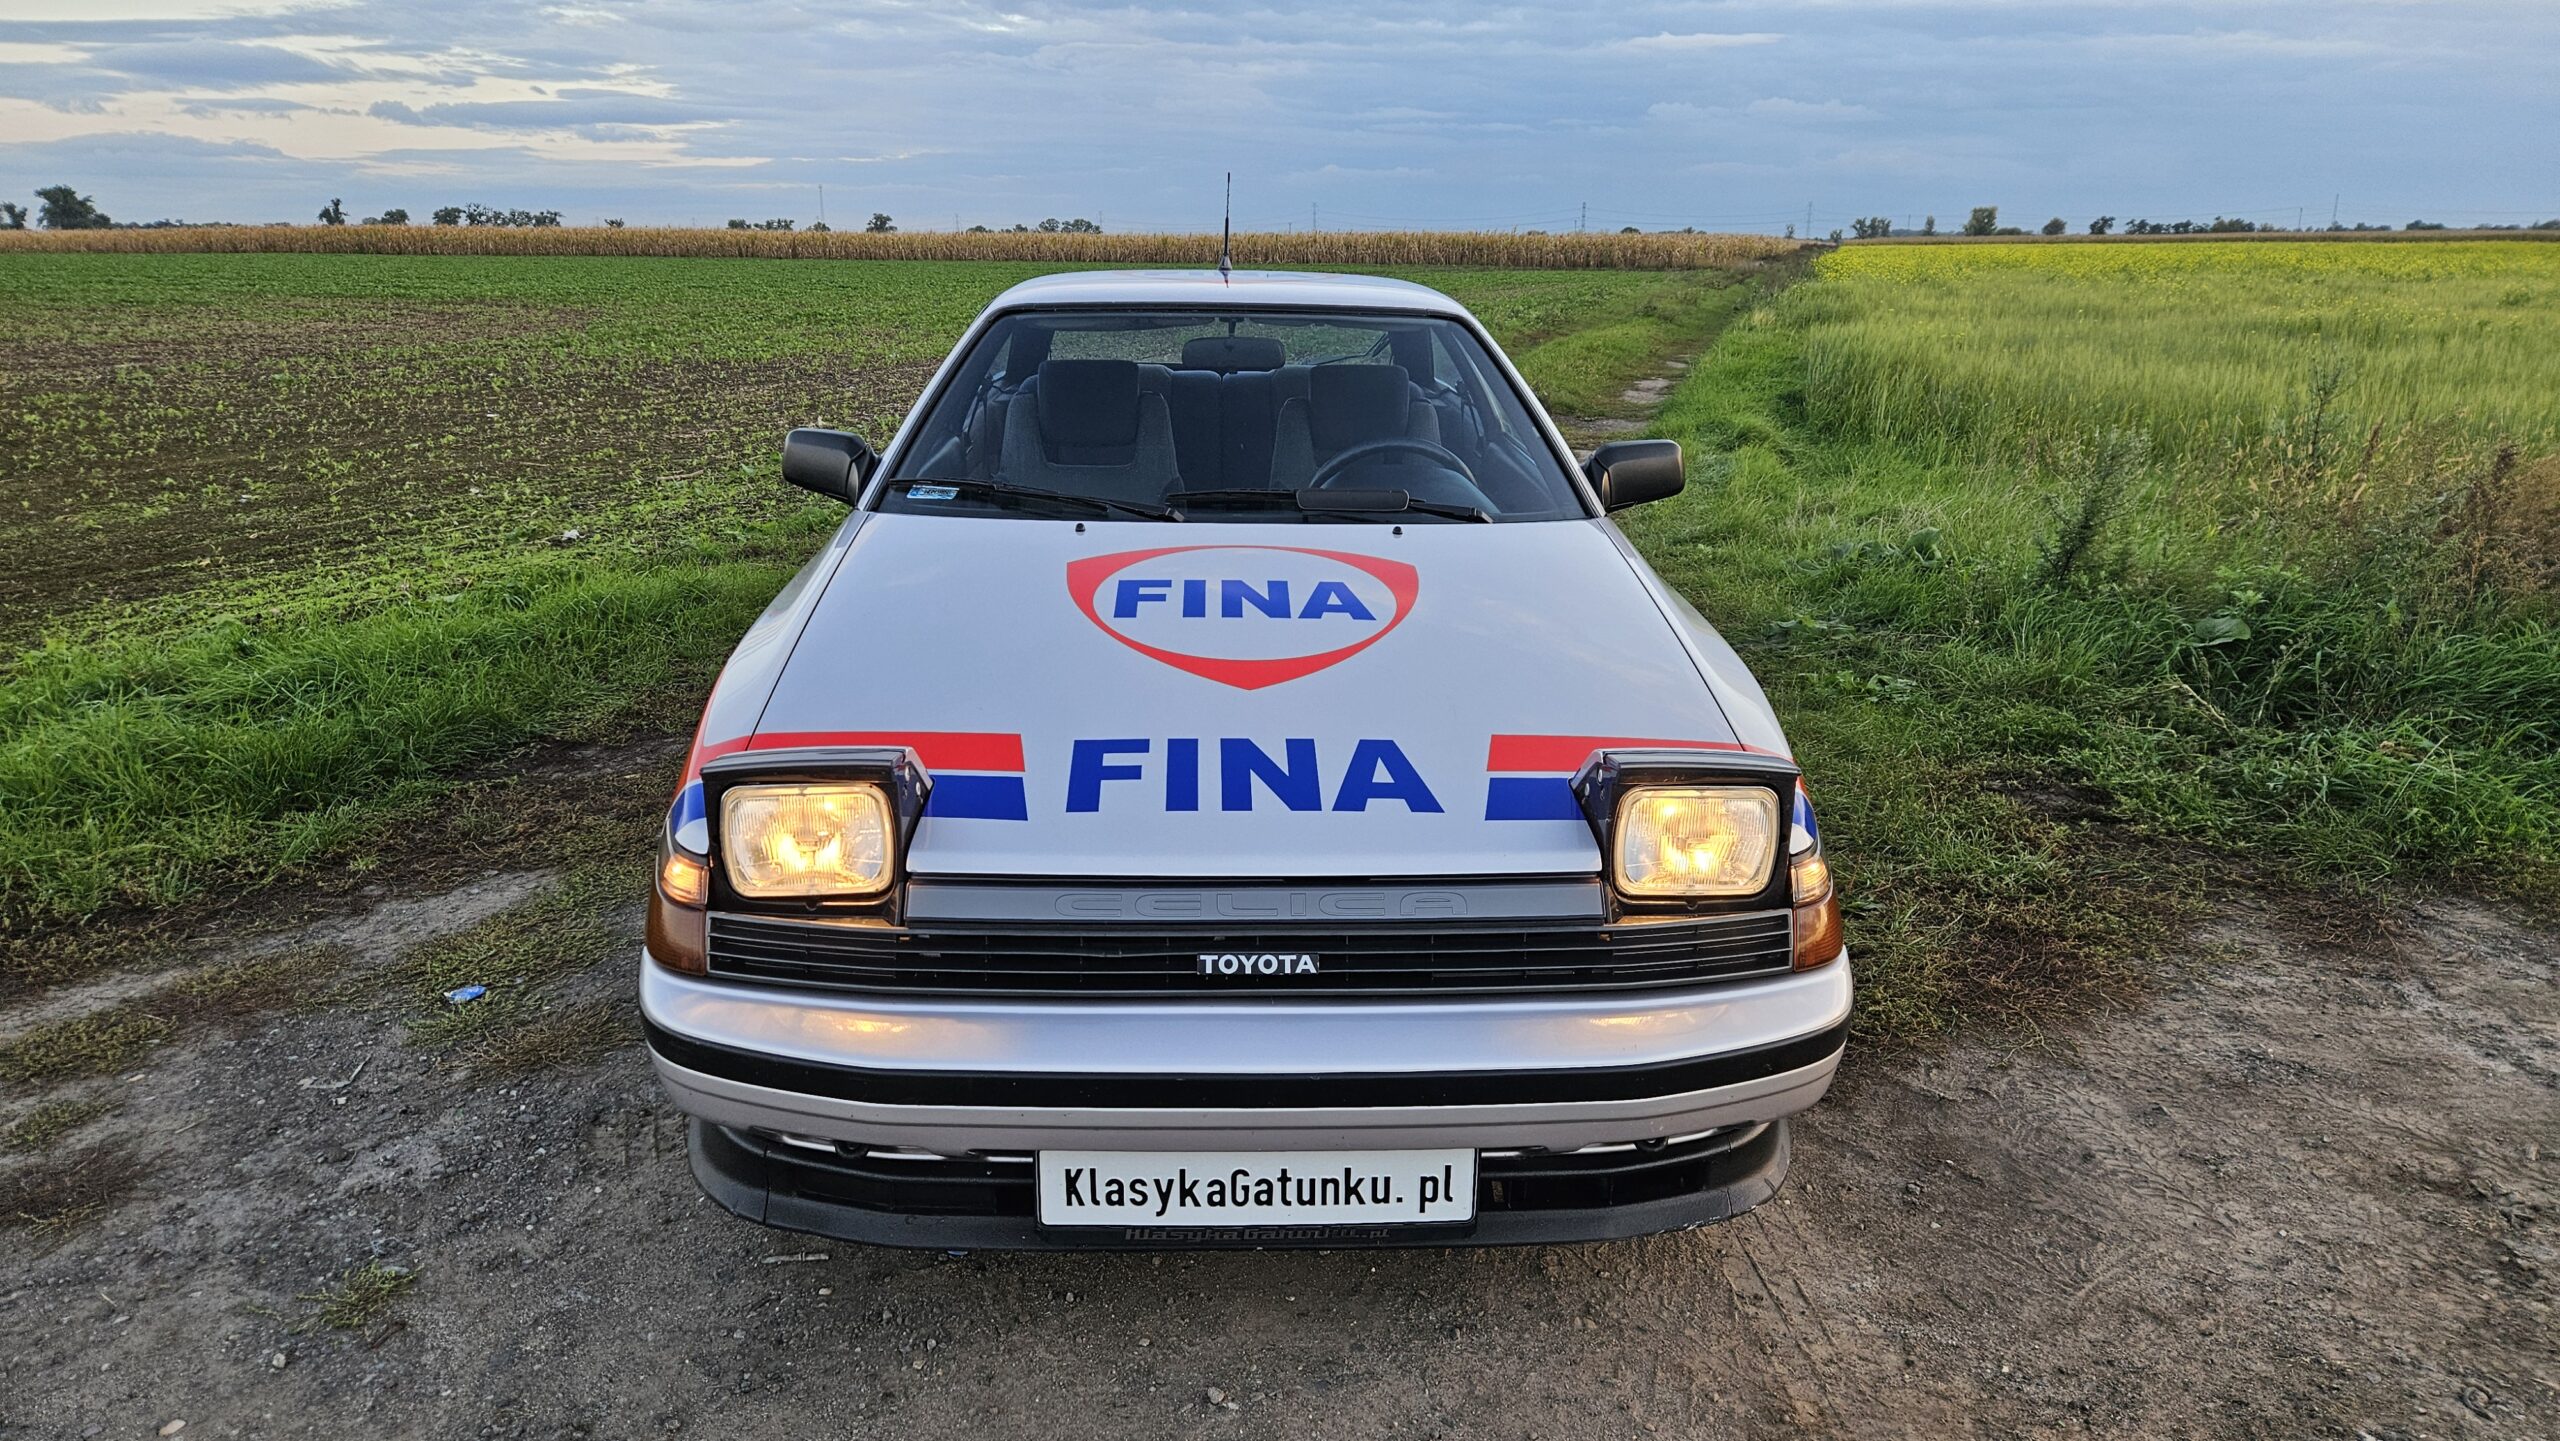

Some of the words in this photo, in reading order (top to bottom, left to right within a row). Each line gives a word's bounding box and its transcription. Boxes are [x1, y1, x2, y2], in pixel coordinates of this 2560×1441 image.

[1114, 579, 1377, 621] FINA
[1066, 738, 1445, 813] FINA
[1055, 893, 1468, 917] CELICA
[1200, 955, 1318, 974] TOYOTA
